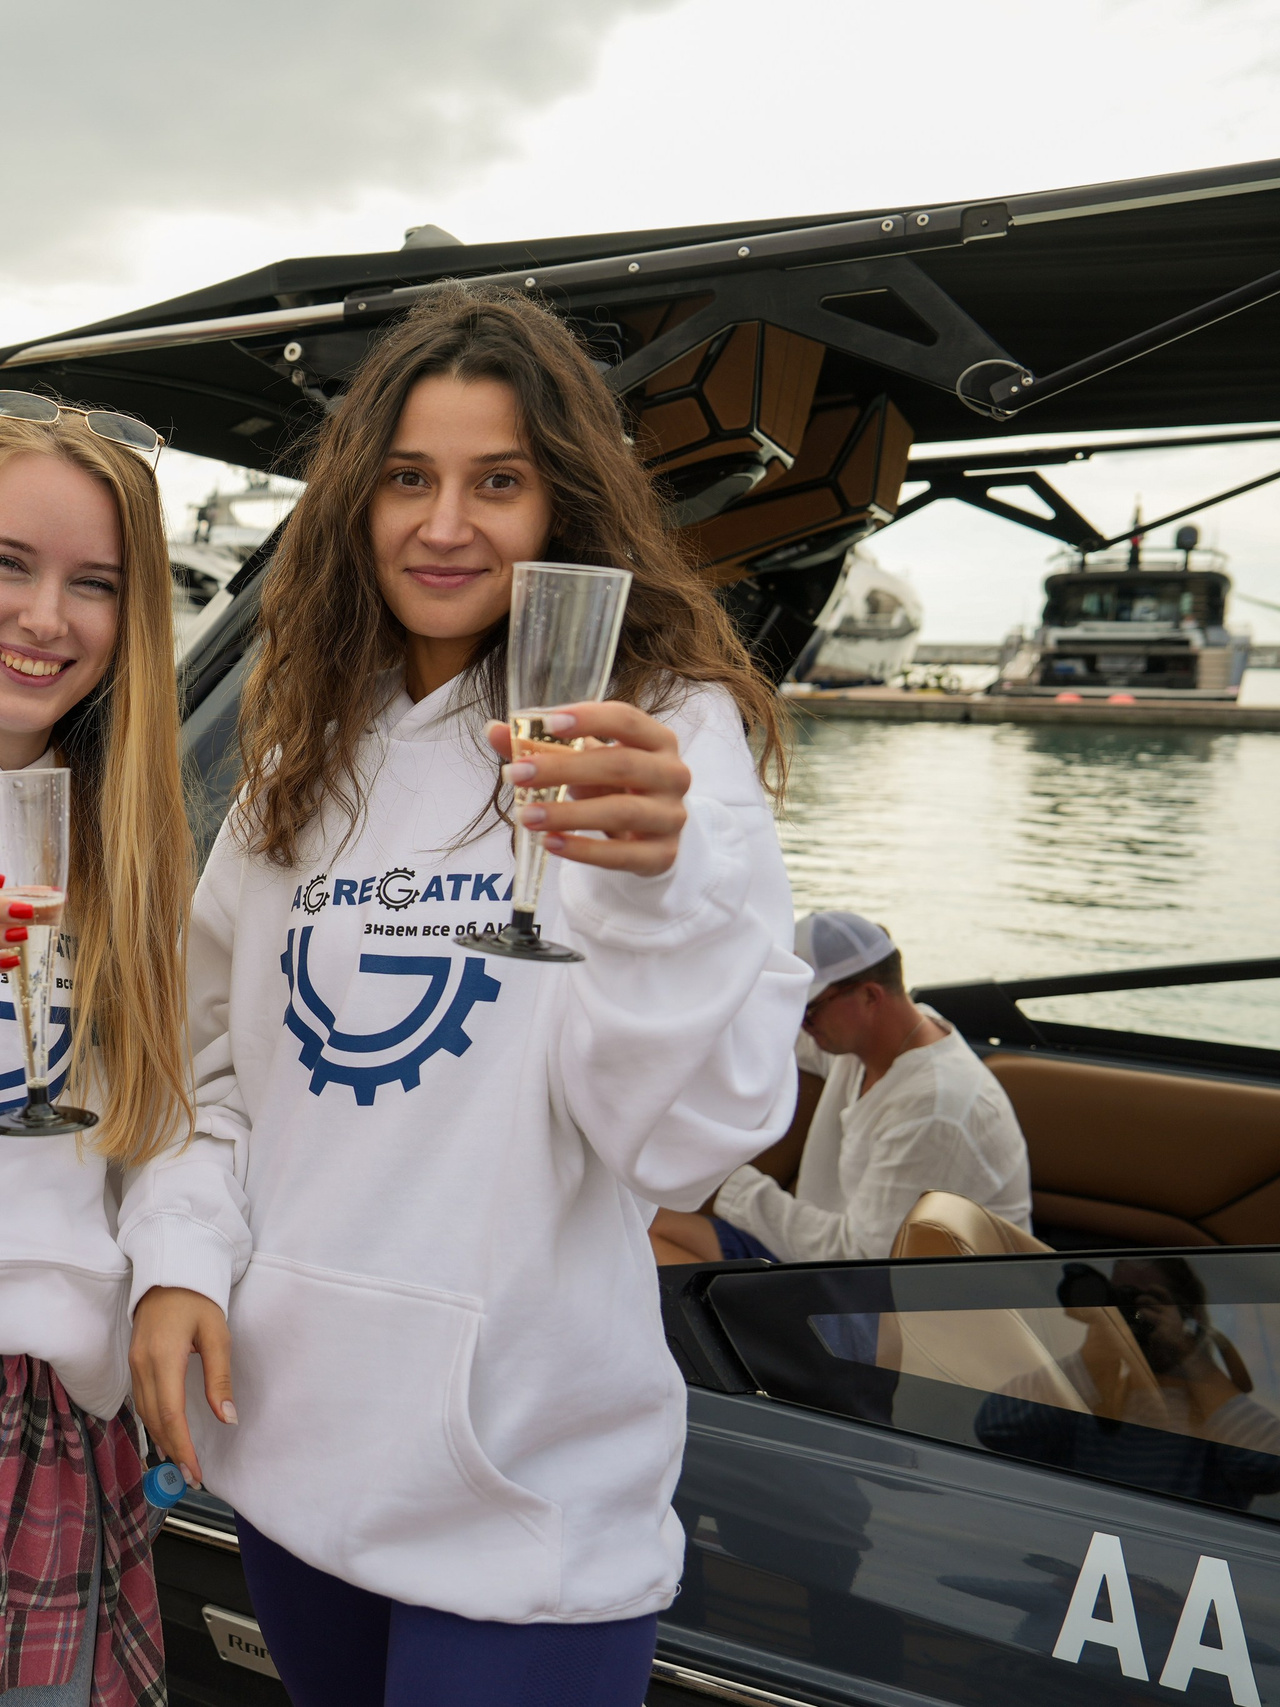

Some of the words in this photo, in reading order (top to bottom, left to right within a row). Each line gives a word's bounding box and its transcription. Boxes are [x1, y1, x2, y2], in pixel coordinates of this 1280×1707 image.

[363, 923, 418, 937] знаем
[422, 924, 451, 937] все
[455, 921, 477, 937] об
[1051, 1531, 1262, 1707] AA
